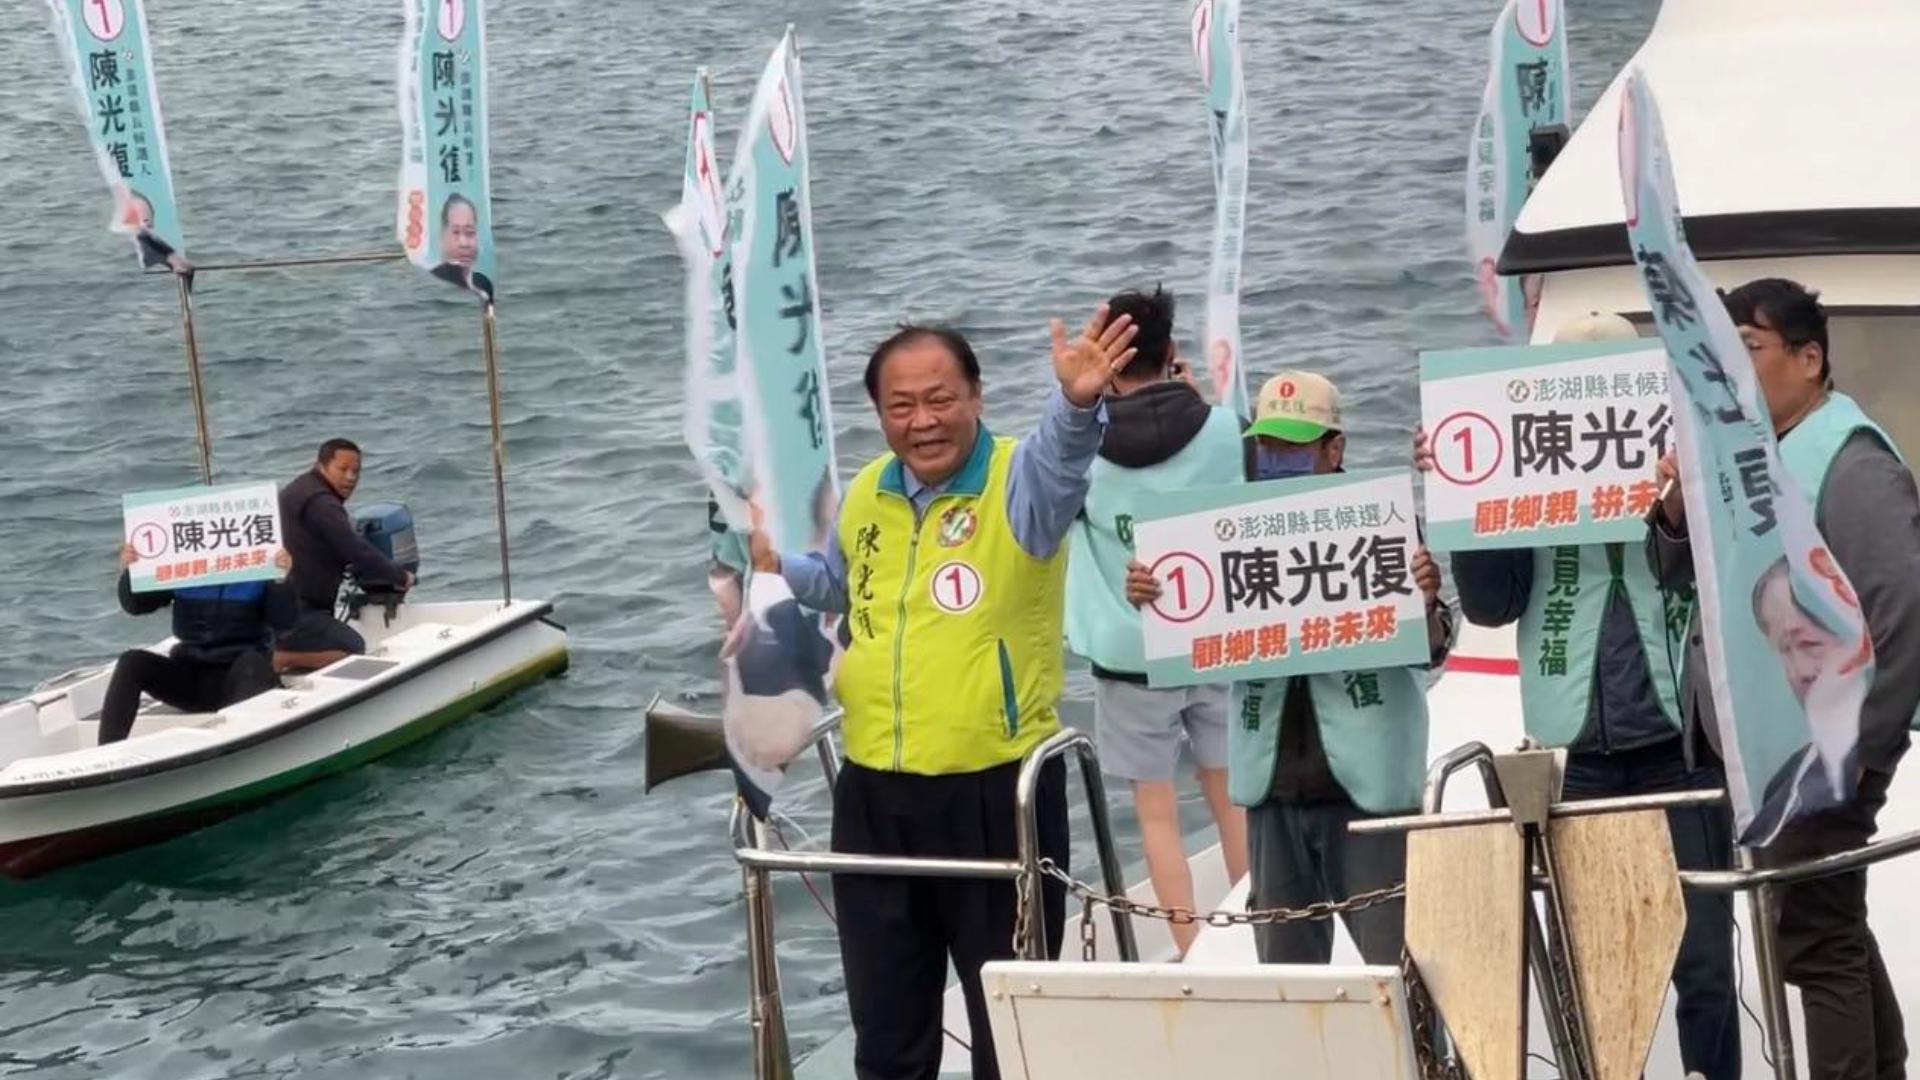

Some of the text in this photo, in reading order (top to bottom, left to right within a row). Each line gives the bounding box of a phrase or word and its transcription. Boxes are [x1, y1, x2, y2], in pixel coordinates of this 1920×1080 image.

[1452, 427, 1473, 473] 1
[172, 514, 276, 553] 陳光復
[1237, 500, 1406, 541] 澎湖縣長候選人
[1474, 487, 1580, 535] 顧鄉親
[945, 566, 962, 606] 1
[1166, 565, 1187, 611] 1
[1220, 535, 1413, 614] 陳光復
[1190, 622, 1289, 672] 顧鄉親
[1344, 672, 1384, 709] 復
